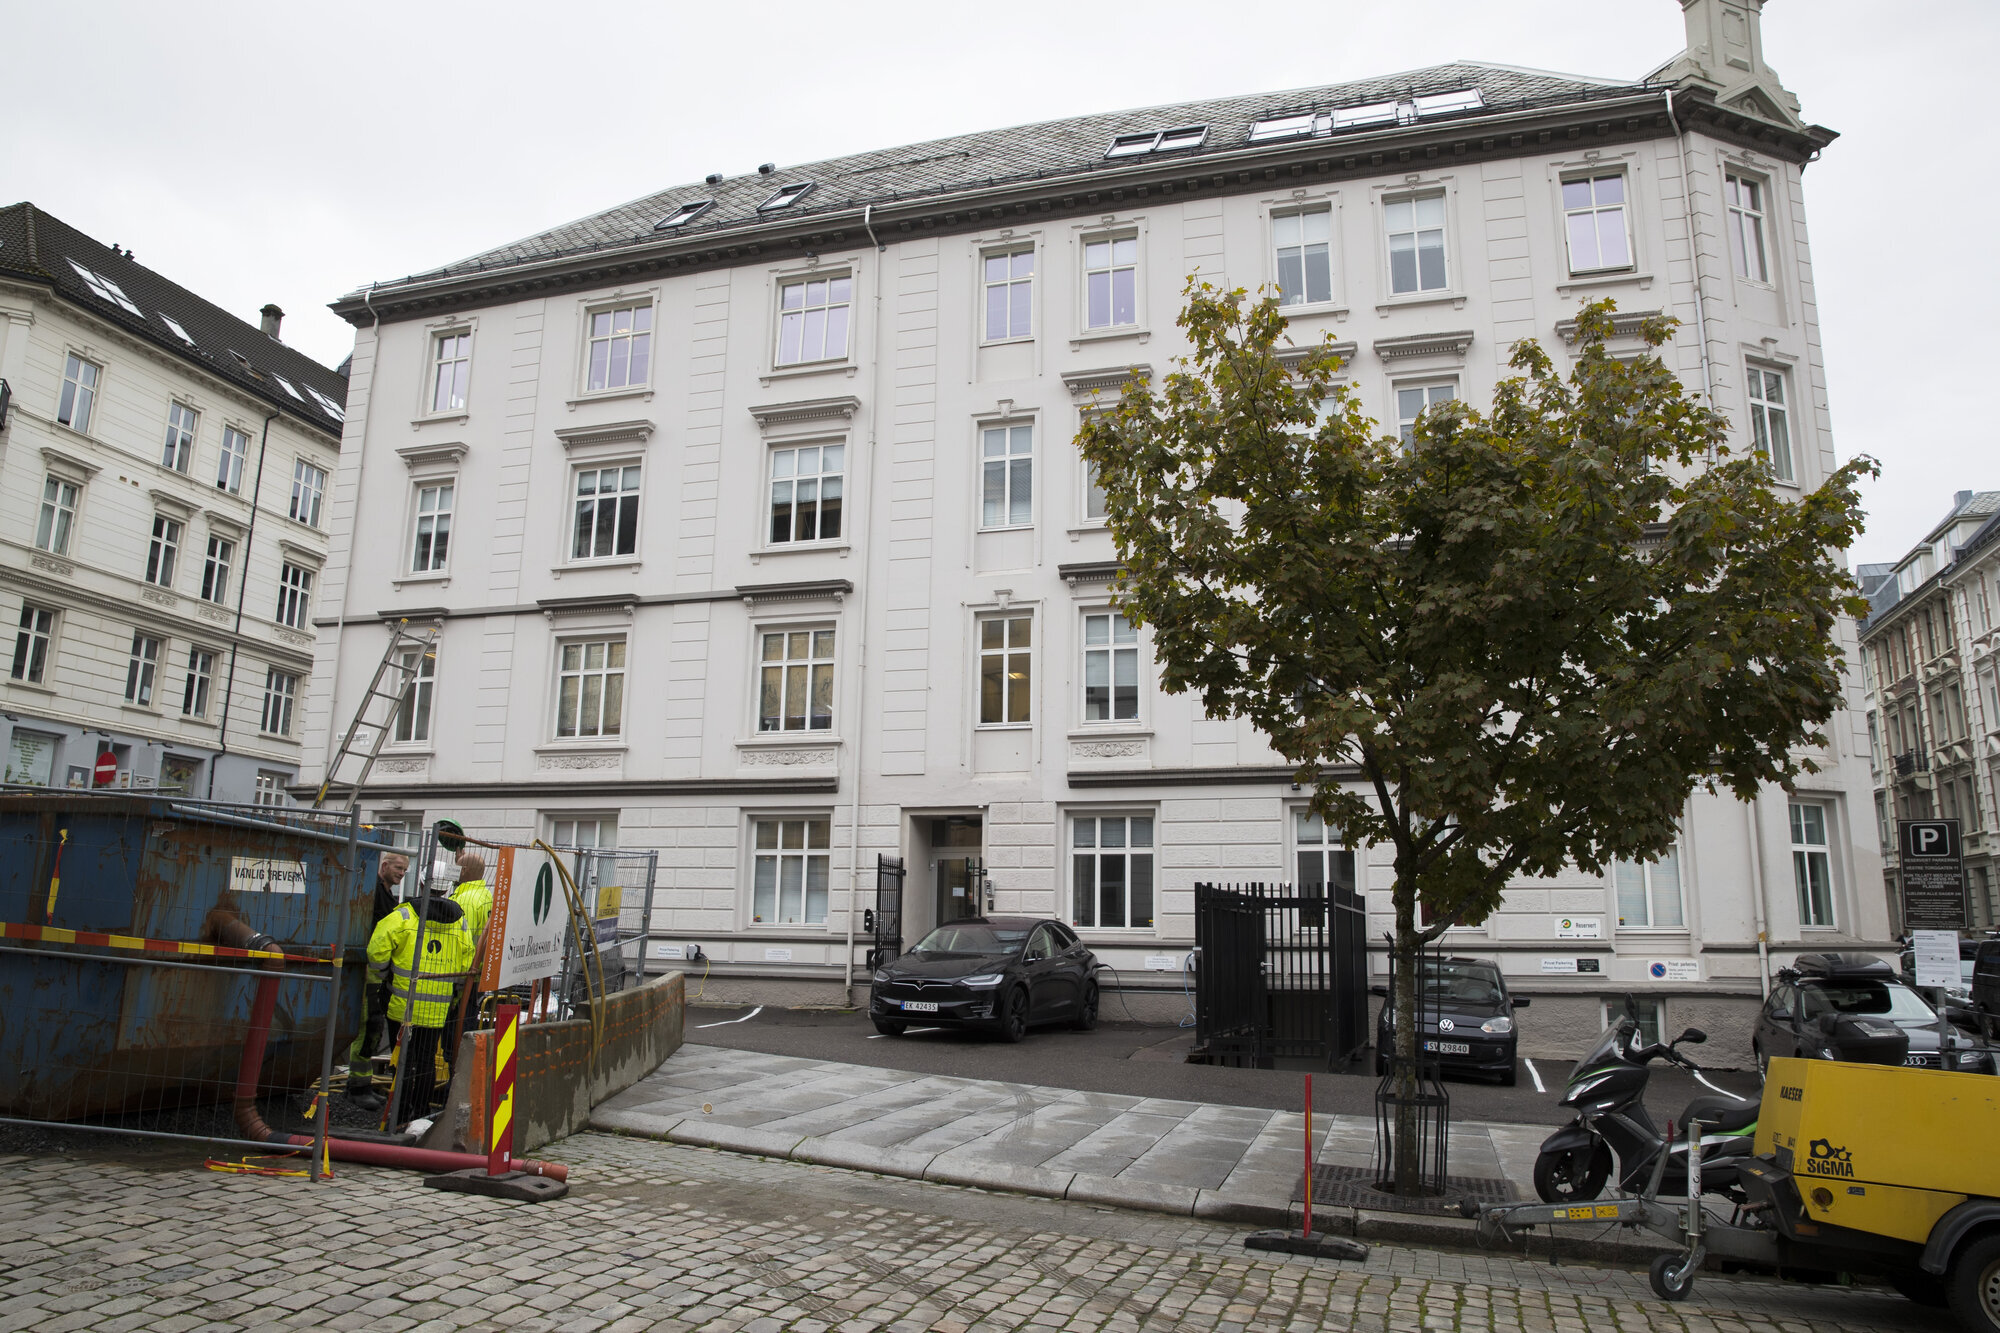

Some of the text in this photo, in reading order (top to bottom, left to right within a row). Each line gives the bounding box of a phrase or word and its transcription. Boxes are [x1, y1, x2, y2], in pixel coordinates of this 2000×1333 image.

[1920, 828, 1939, 852] P
[235, 867, 264, 879] VANLIG
[508, 937, 525, 960] Svein
[525, 936, 551, 957] Boasson
[1442, 1043, 1468, 1053] 29840
[1780, 1086, 1803, 1102] KAESER
[1807, 1159, 1854, 1177] SIGMA
